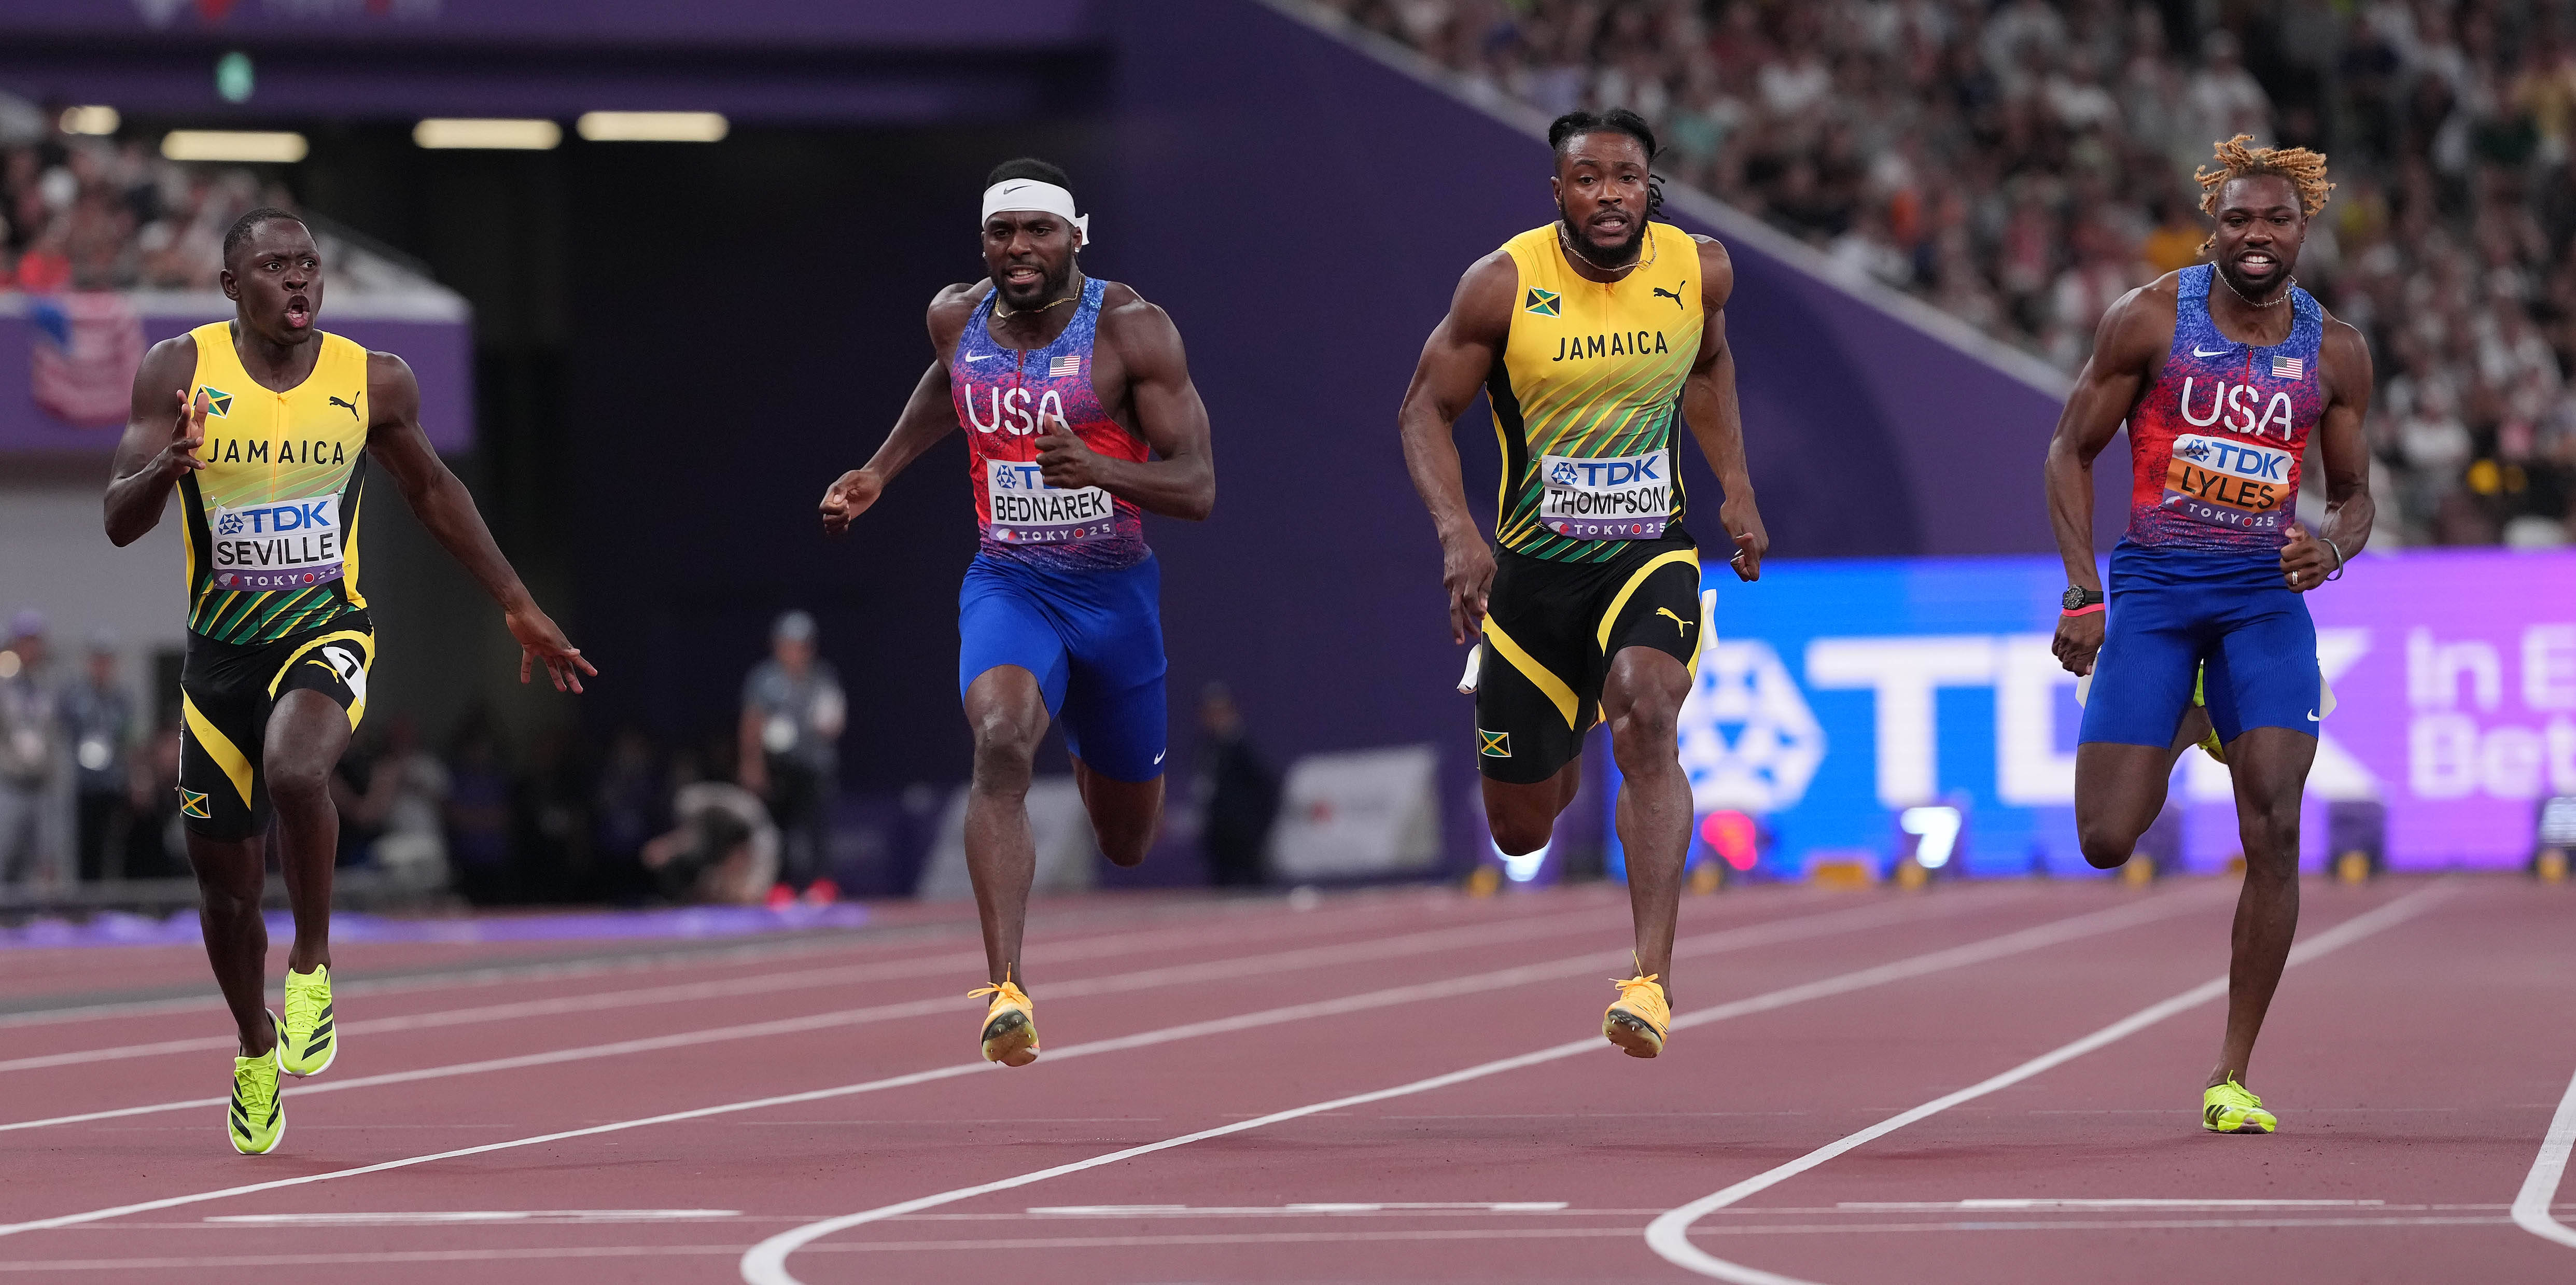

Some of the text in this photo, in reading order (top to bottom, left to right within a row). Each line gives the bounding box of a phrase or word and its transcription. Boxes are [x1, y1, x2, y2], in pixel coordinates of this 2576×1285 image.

[1552, 331, 1669, 361] JAMAICA
[965, 384, 1074, 436] USA
[2181, 376, 2292, 441] USA
[207, 438, 344, 465] JAMAICA
[2211, 441, 2286, 480] TDK
[1577, 455, 1660, 486] TDK
[1550, 485, 1665, 514] THOMPSON
[2181, 466, 2275, 509] LYLES
[242, 500, 331, 533] TDK
[995, 490, 1107, 522] BEDNAREK
[216, 532, 334, 566] SEVILLE
[1900, 807, 1962, 868] 7
